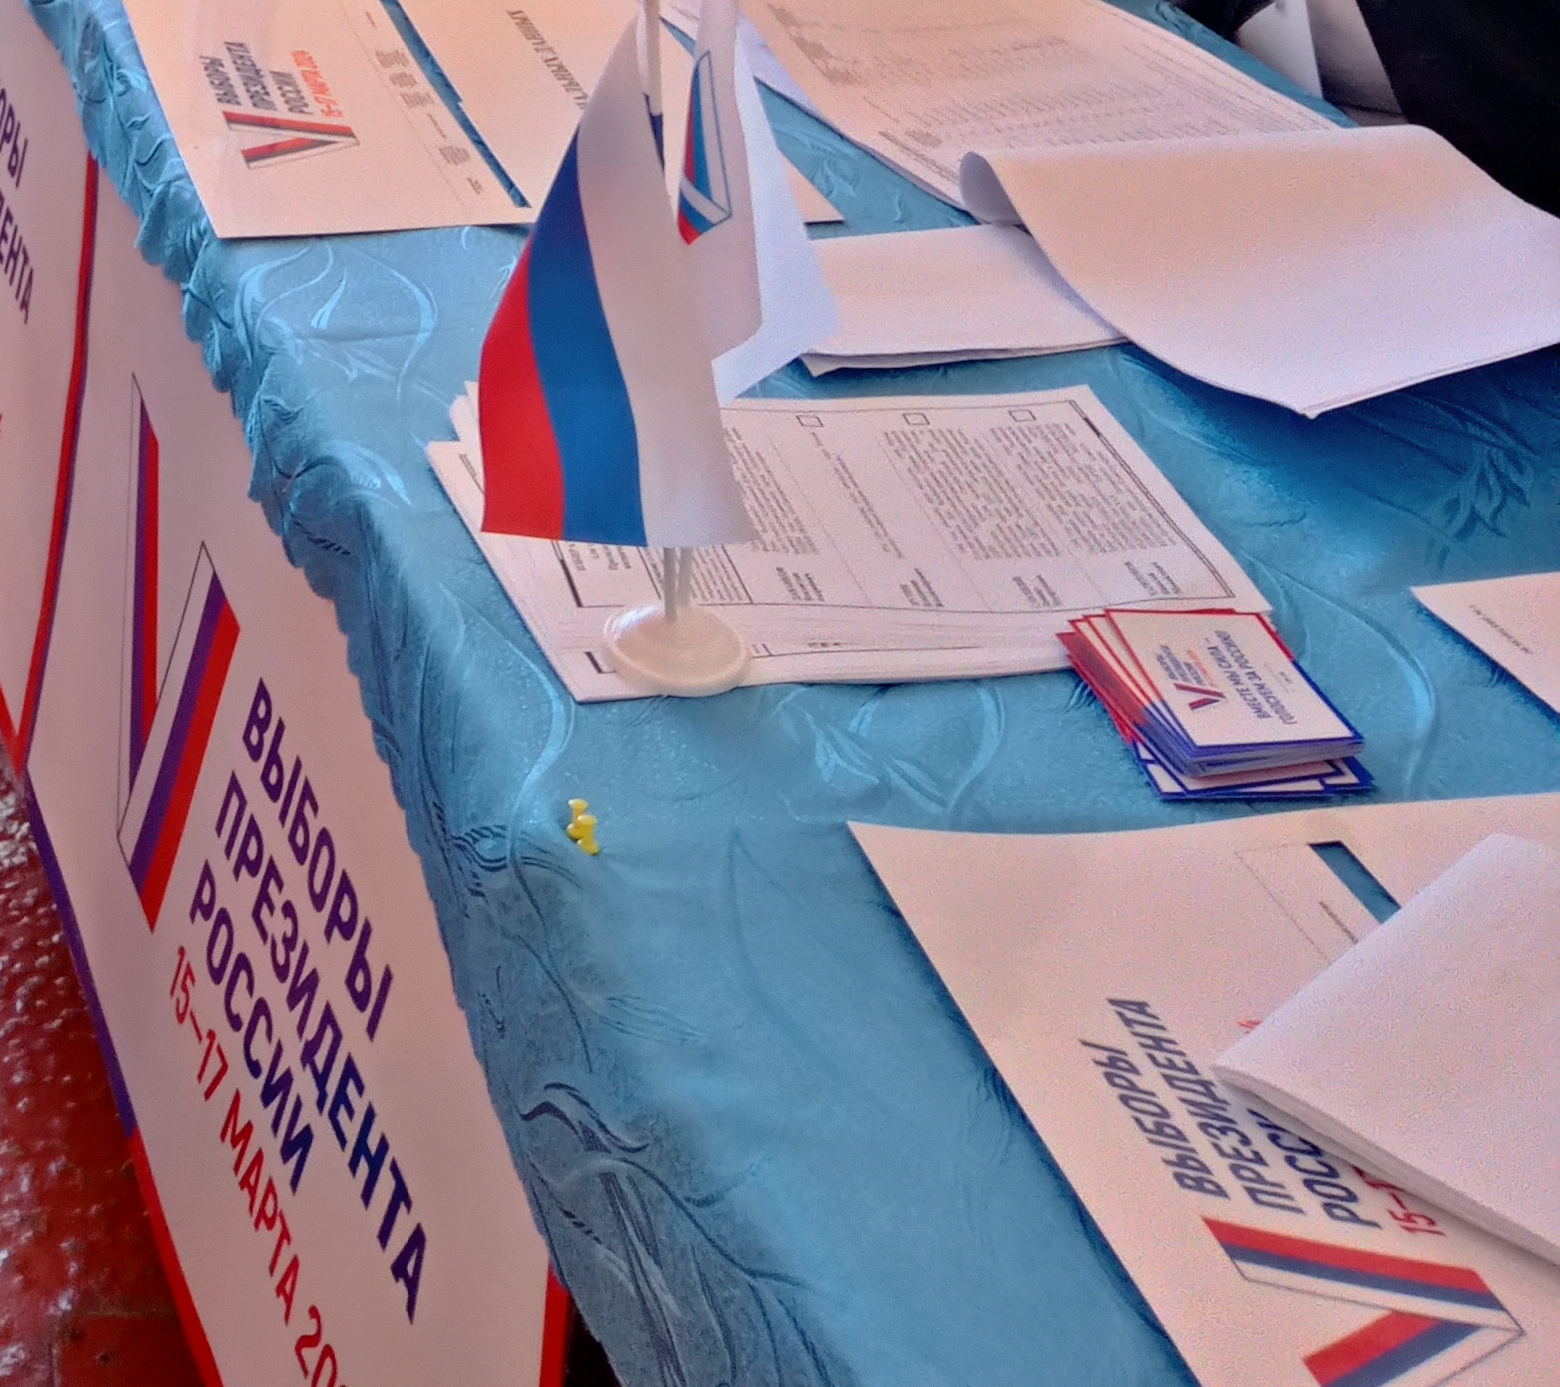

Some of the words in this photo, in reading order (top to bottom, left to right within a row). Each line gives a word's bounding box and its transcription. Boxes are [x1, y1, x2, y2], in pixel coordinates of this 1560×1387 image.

[1206, 645, 1232, 672] СИЛА
[1224, 670, 1245, 687] МЫ
[1235, 686, 1273, 719] ВМЕСТЕ
[1244, 670, 1262, 685] ЗА
[242, 677, 394, 1044] ВЫБОРЫ
[190, 858, 315, 1197] РОССИИ
[215, 770, 427, 1325] ПРЕЗИДЕНТА
[1105, 997, 1307, 1216] ПРЕЗИДЕНТА
[1080, 1038, 1232, 1201] ВЫБОРЫ
[1247, 1107, 1383, 1230] РОСС
[219, 1088, 301, 1327] МАРТА
[295, 1305, 347, 1387] 20
